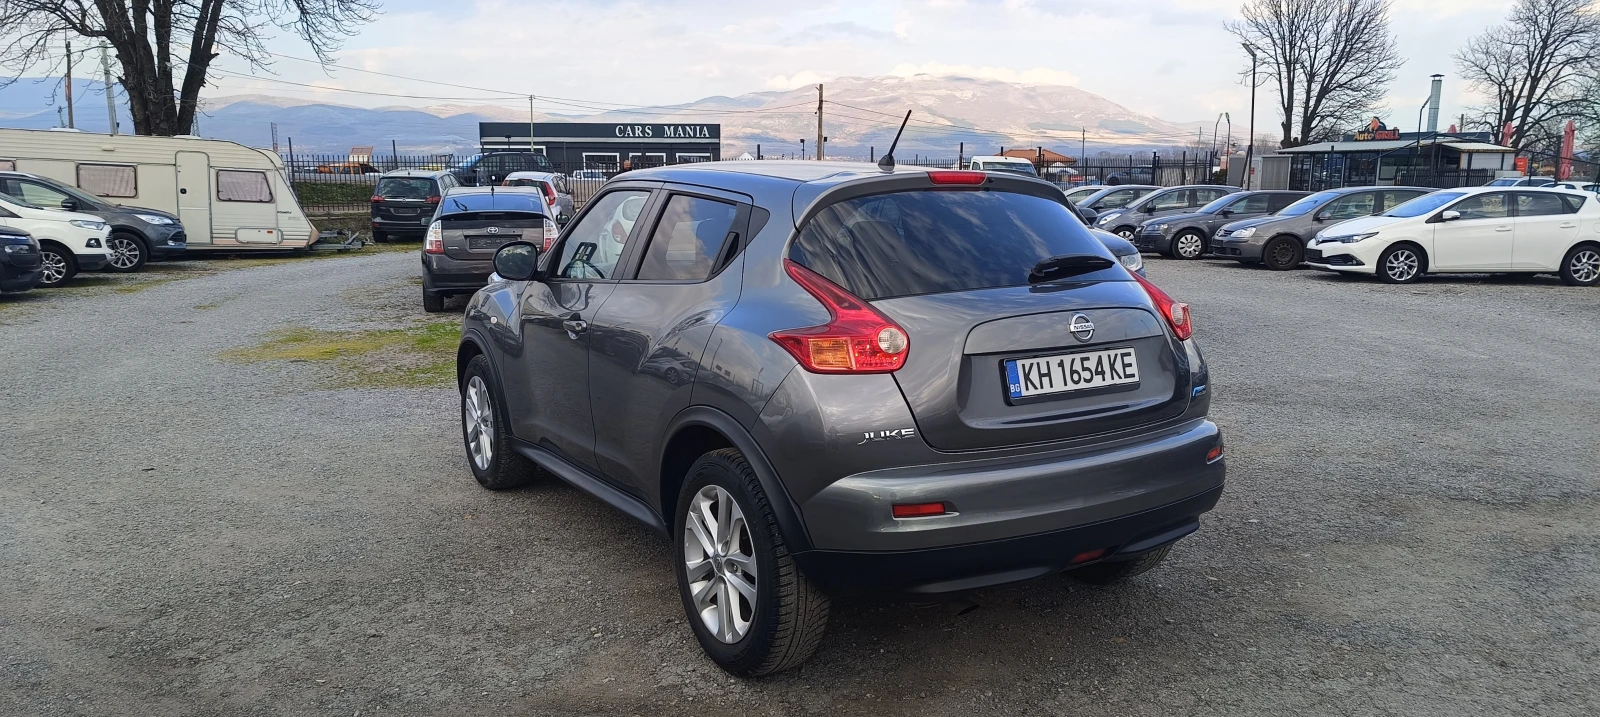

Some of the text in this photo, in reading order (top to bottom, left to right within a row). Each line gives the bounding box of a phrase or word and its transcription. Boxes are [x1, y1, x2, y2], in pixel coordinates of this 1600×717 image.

[615, 125, 710, 138] CARS MANIA
[1354, 130, 1399, 140] Auto GRILL
[1021, 351, 1136, 392] KH 1654 KE
[1009, 383, 1020, 393] BG
[857, 428, 915, 445] JUKE
